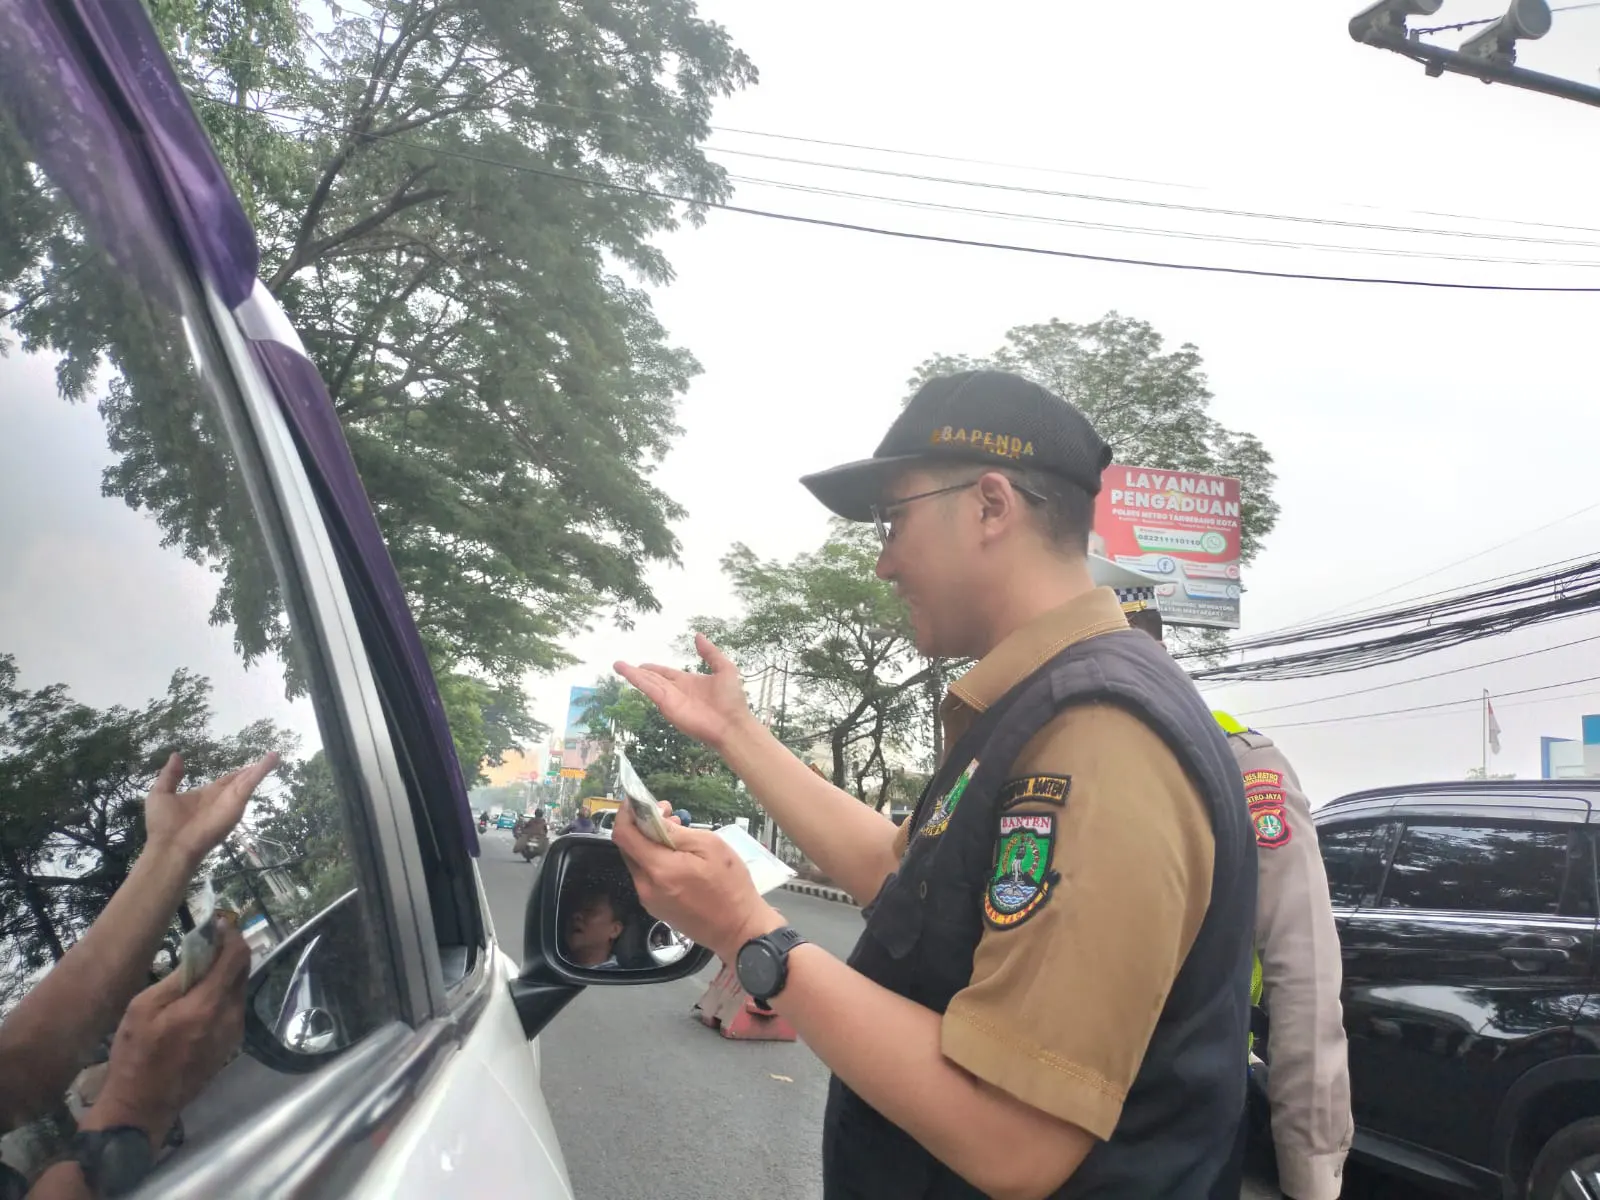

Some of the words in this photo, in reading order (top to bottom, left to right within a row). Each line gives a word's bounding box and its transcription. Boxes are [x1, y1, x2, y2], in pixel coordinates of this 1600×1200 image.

[1125, 471, 1225, 497] LAYANAN
[1111, 489, 1239, 517] PENGADUAN
[1142, 511, 1168, 520] METRO
[1216, 519, 1238, 528] KOTA
[1265, 793, 1282, 801] JAYA
[1002, 815, 1051, 829] BANTEN
